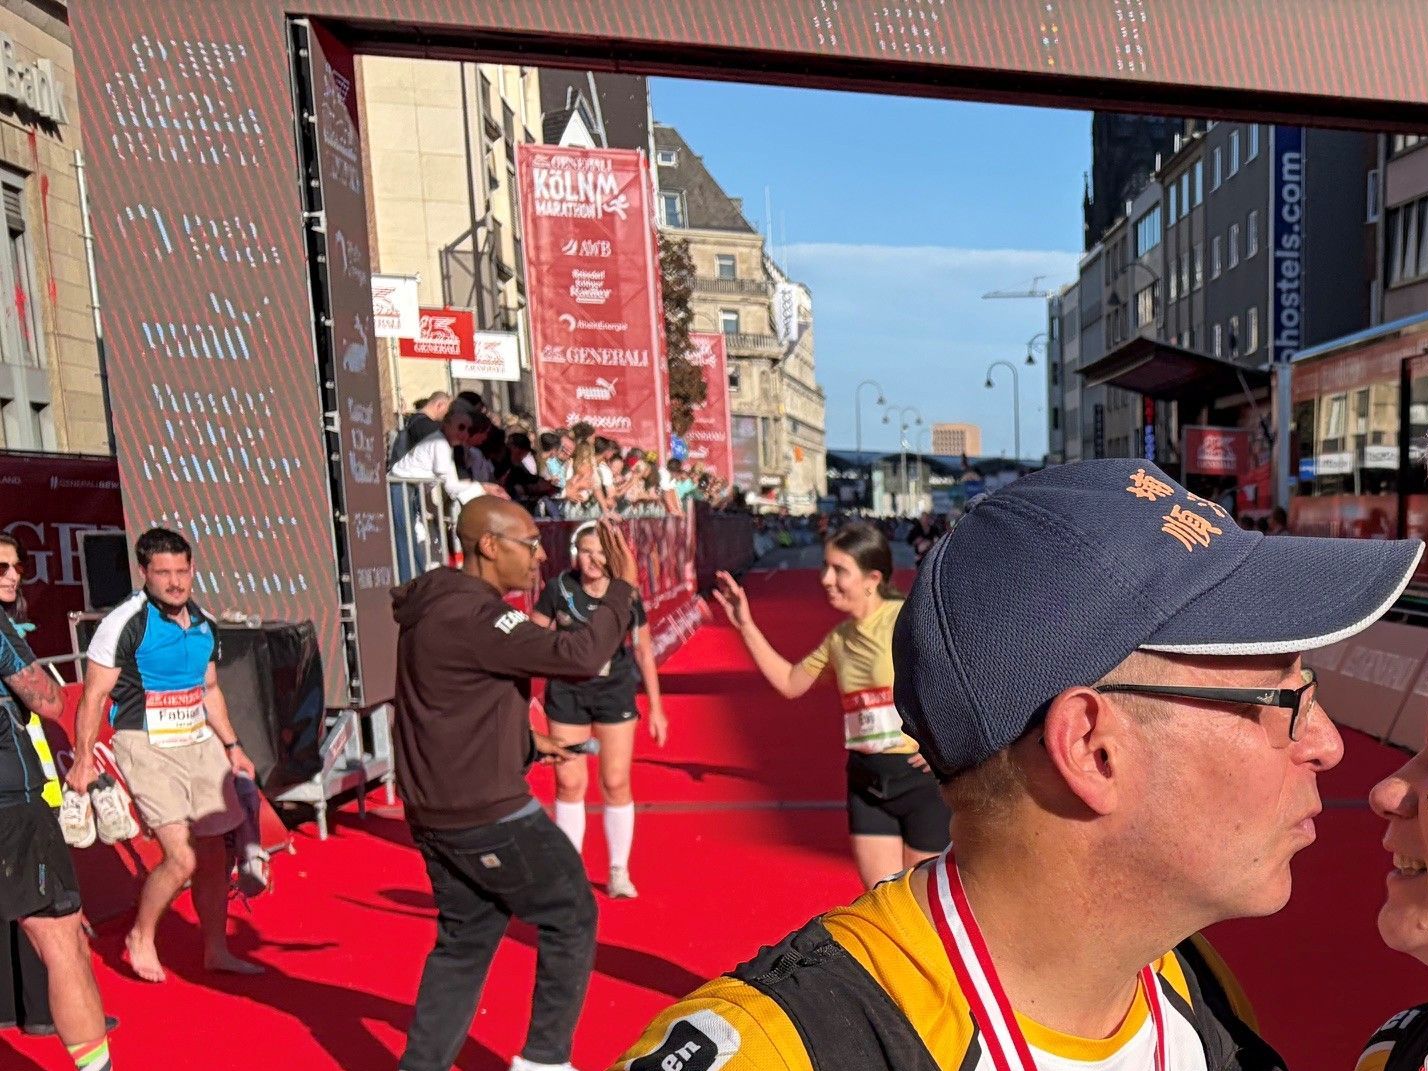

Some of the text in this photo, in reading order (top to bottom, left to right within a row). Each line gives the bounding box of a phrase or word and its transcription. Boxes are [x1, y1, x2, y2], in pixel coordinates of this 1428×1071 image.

[533, 168, 595, 203] KÖLN
[535, 201, 595, 218] MARATHON
[566, 347, 649, 368] GENERALI
